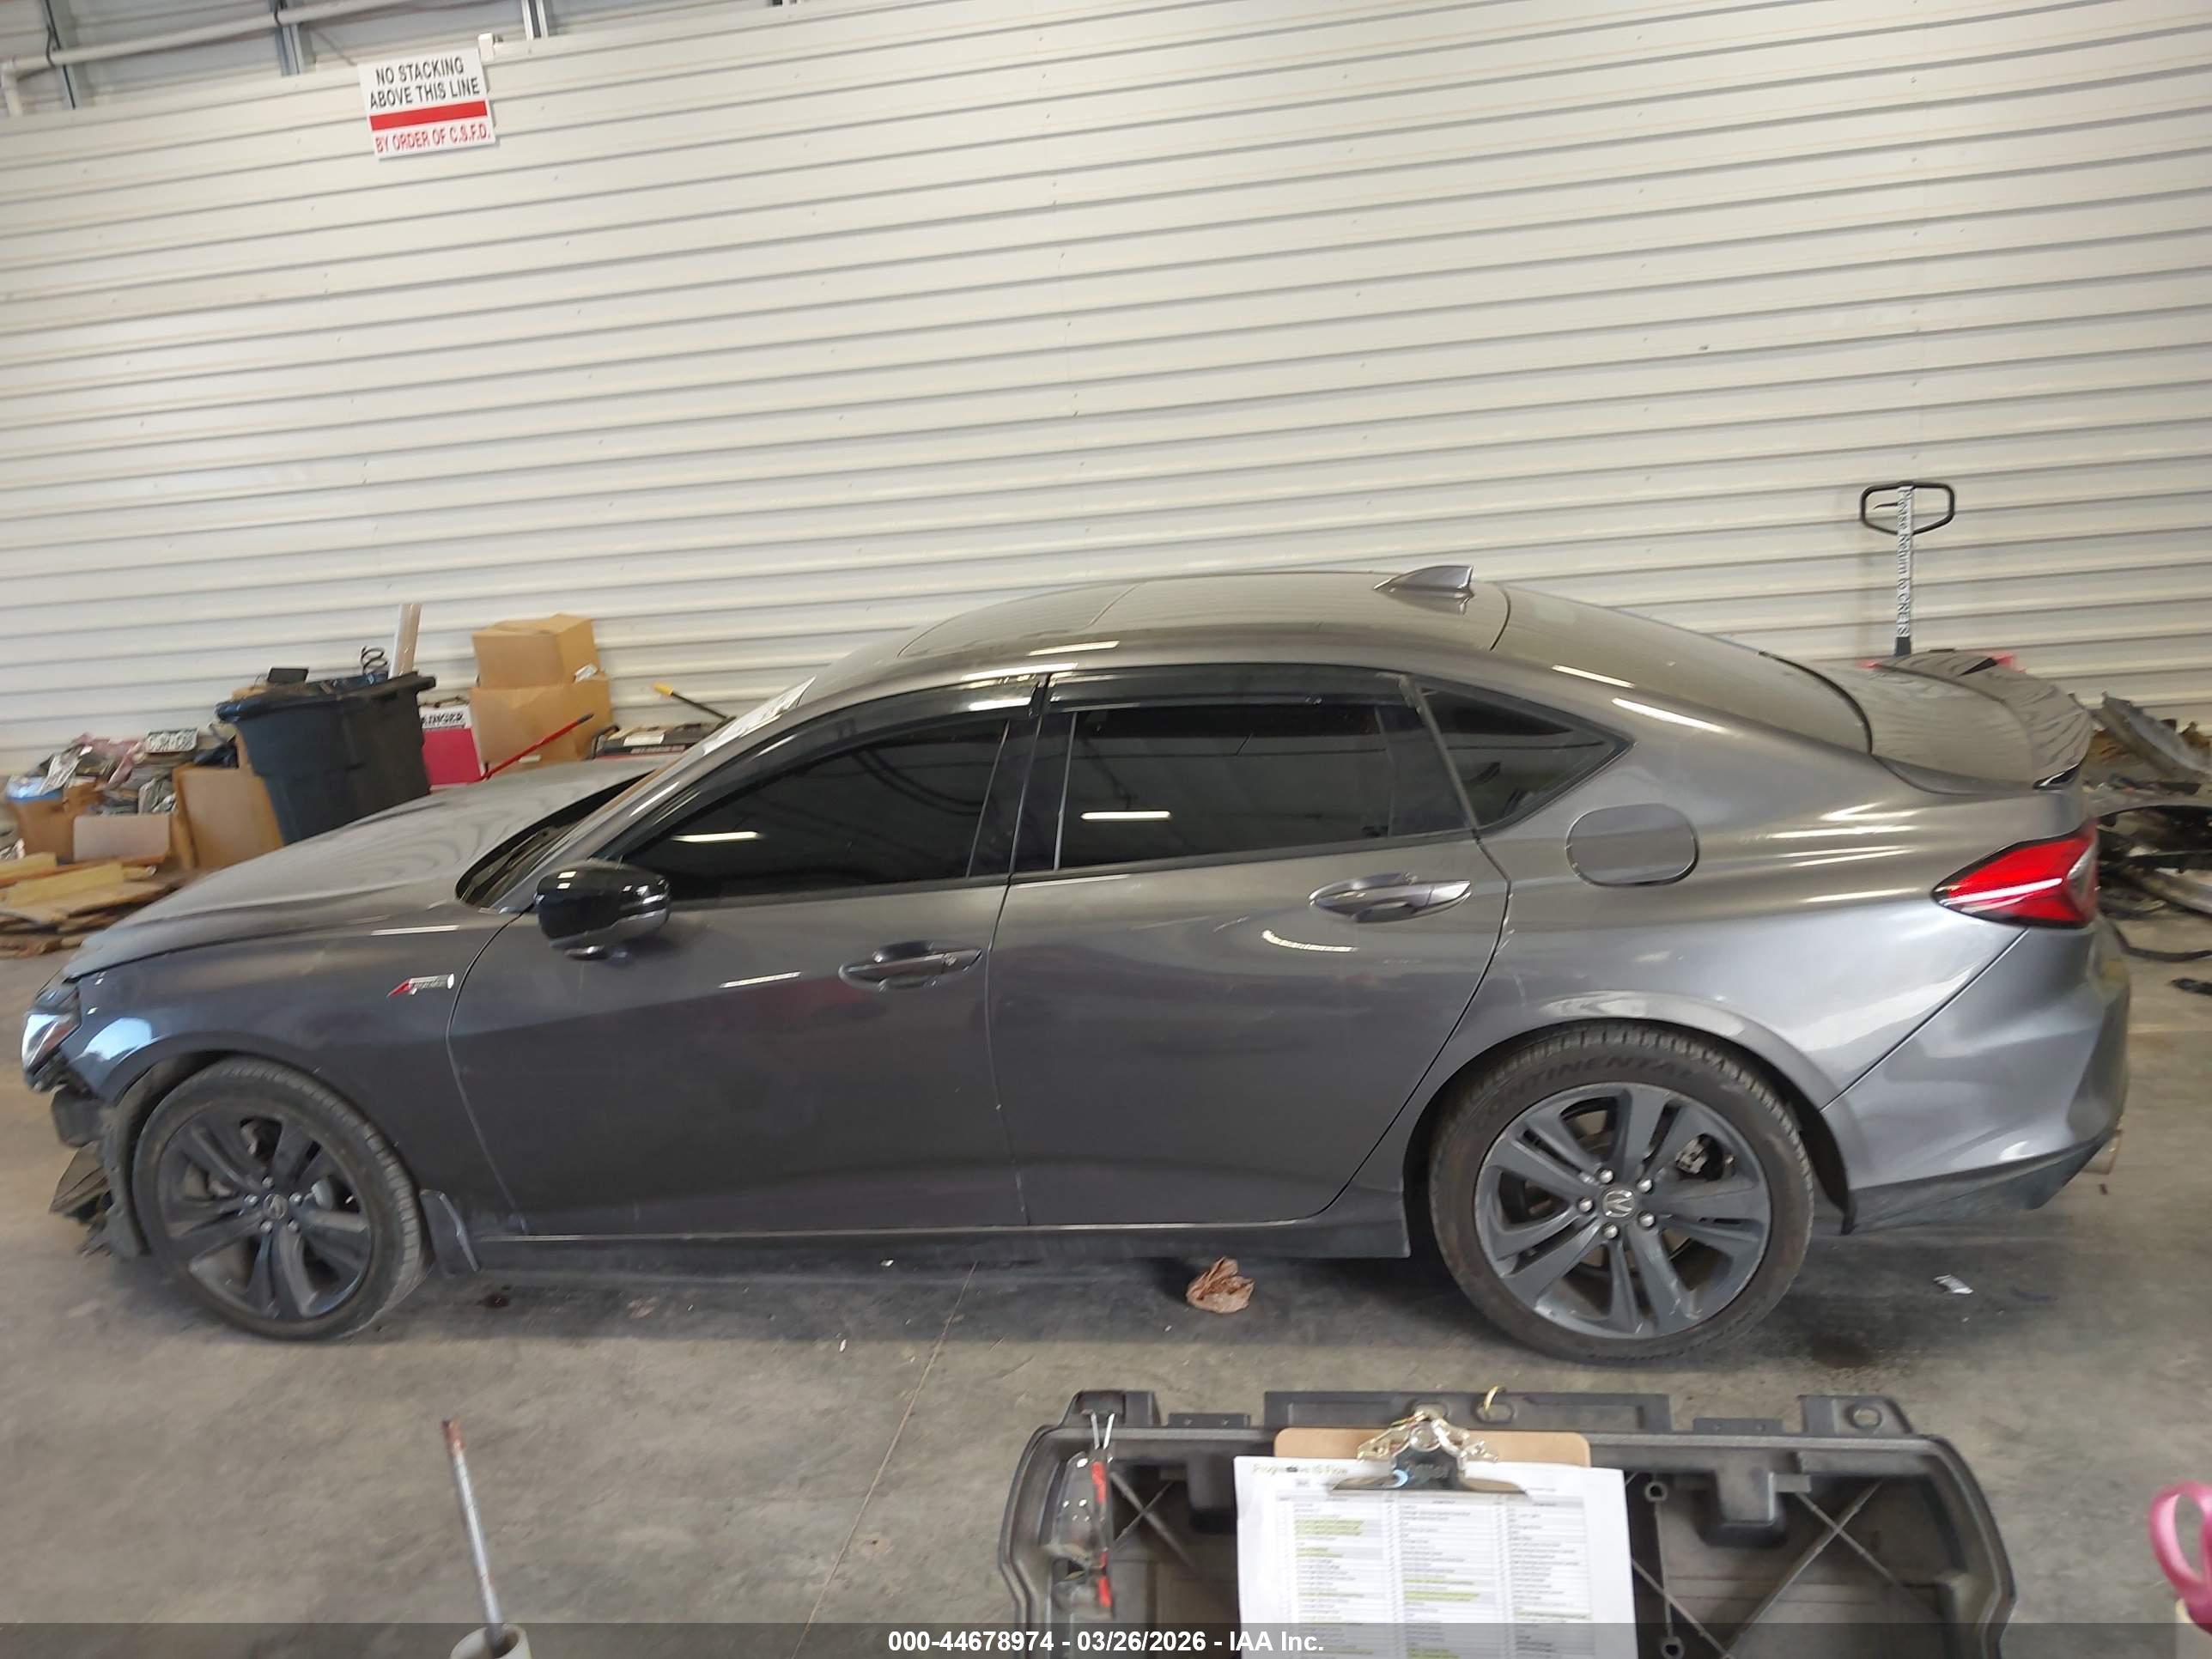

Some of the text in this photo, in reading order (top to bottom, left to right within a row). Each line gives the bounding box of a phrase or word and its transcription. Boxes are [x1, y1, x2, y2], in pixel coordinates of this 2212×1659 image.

[375, 57, 464, 86] NO STACKING
[370, 77, 480, 109] ABOVE THIS LINE
[375, 123, 491, 154] BY ORDER OF C.S.F.D.
[1898, 489, 1911, 530] Please
[1898, 534, 1911, 574] Return
